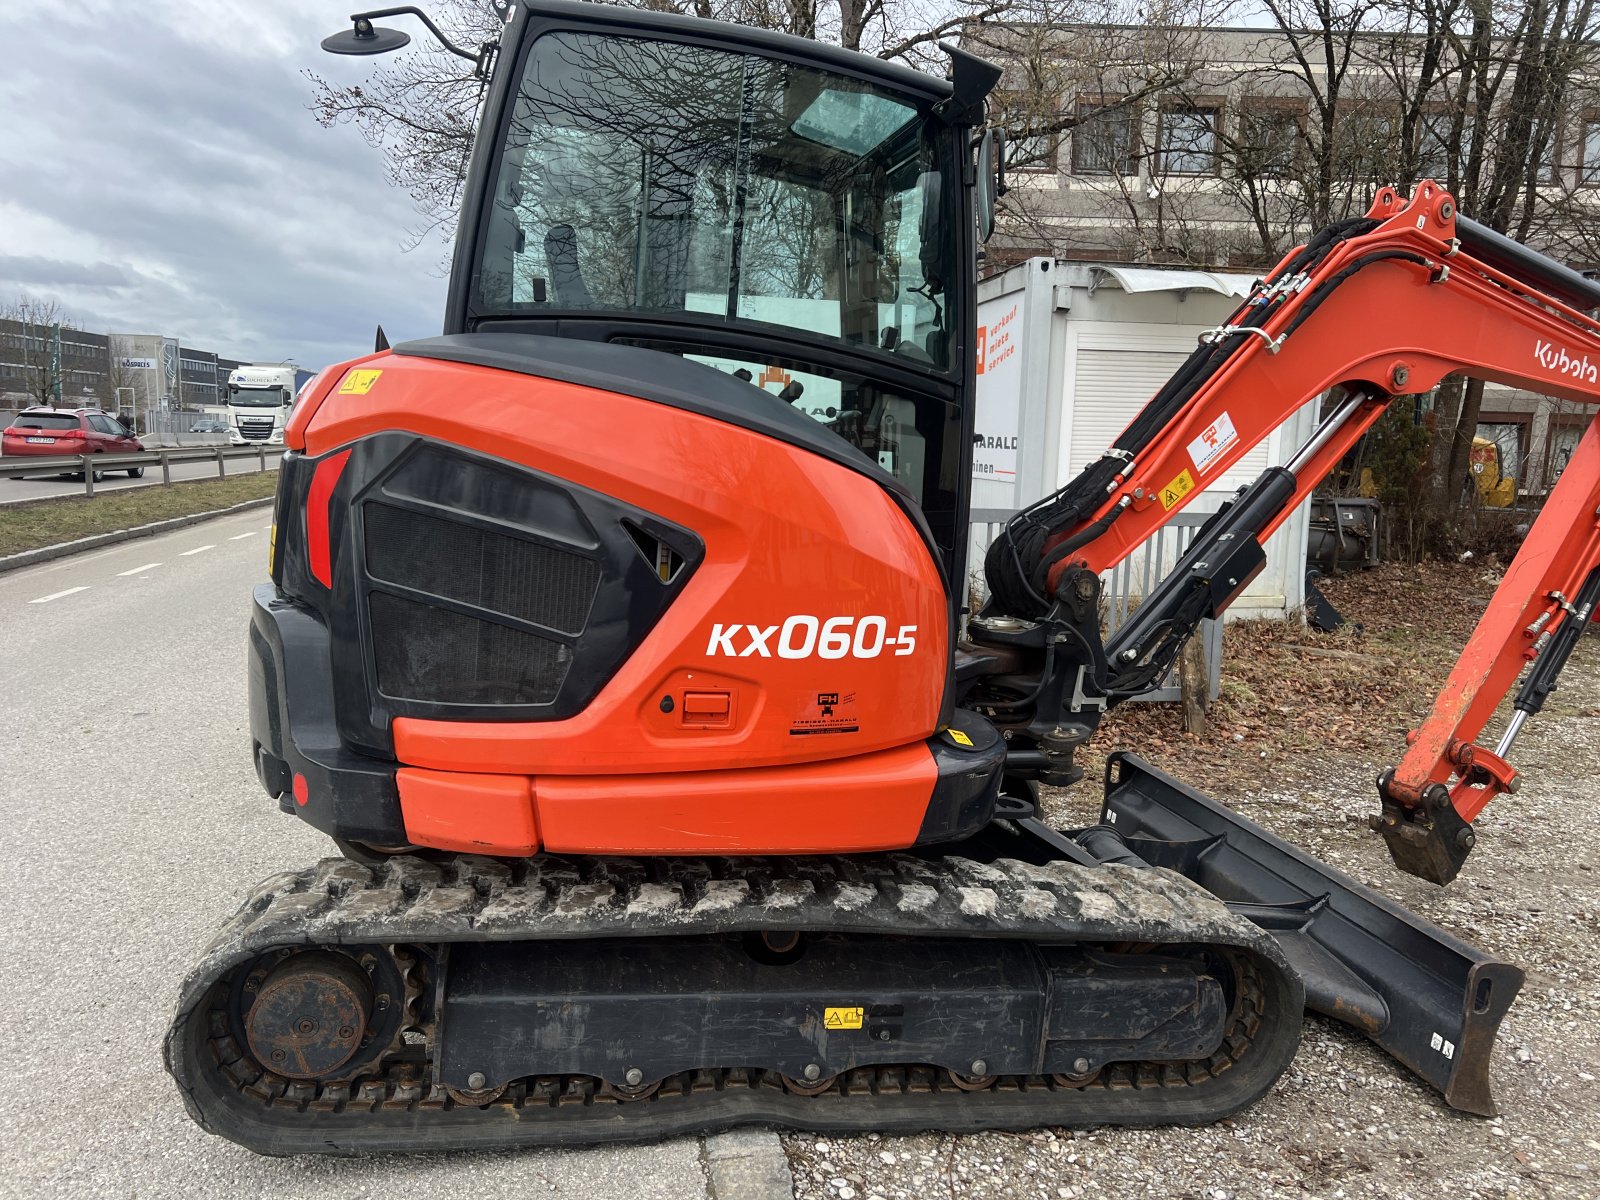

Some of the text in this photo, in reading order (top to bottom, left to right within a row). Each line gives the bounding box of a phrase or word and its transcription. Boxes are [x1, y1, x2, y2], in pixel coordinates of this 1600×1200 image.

[990, 304, 1017, 337] verkauf
[988, 345, 1015, 371] service
[989, 332, 1009, 355] miete
[1534, 339, 1598, 384] Kubota
[705, 614, 918, 660] KX060-5
[819, 696, 837, 704] FH
